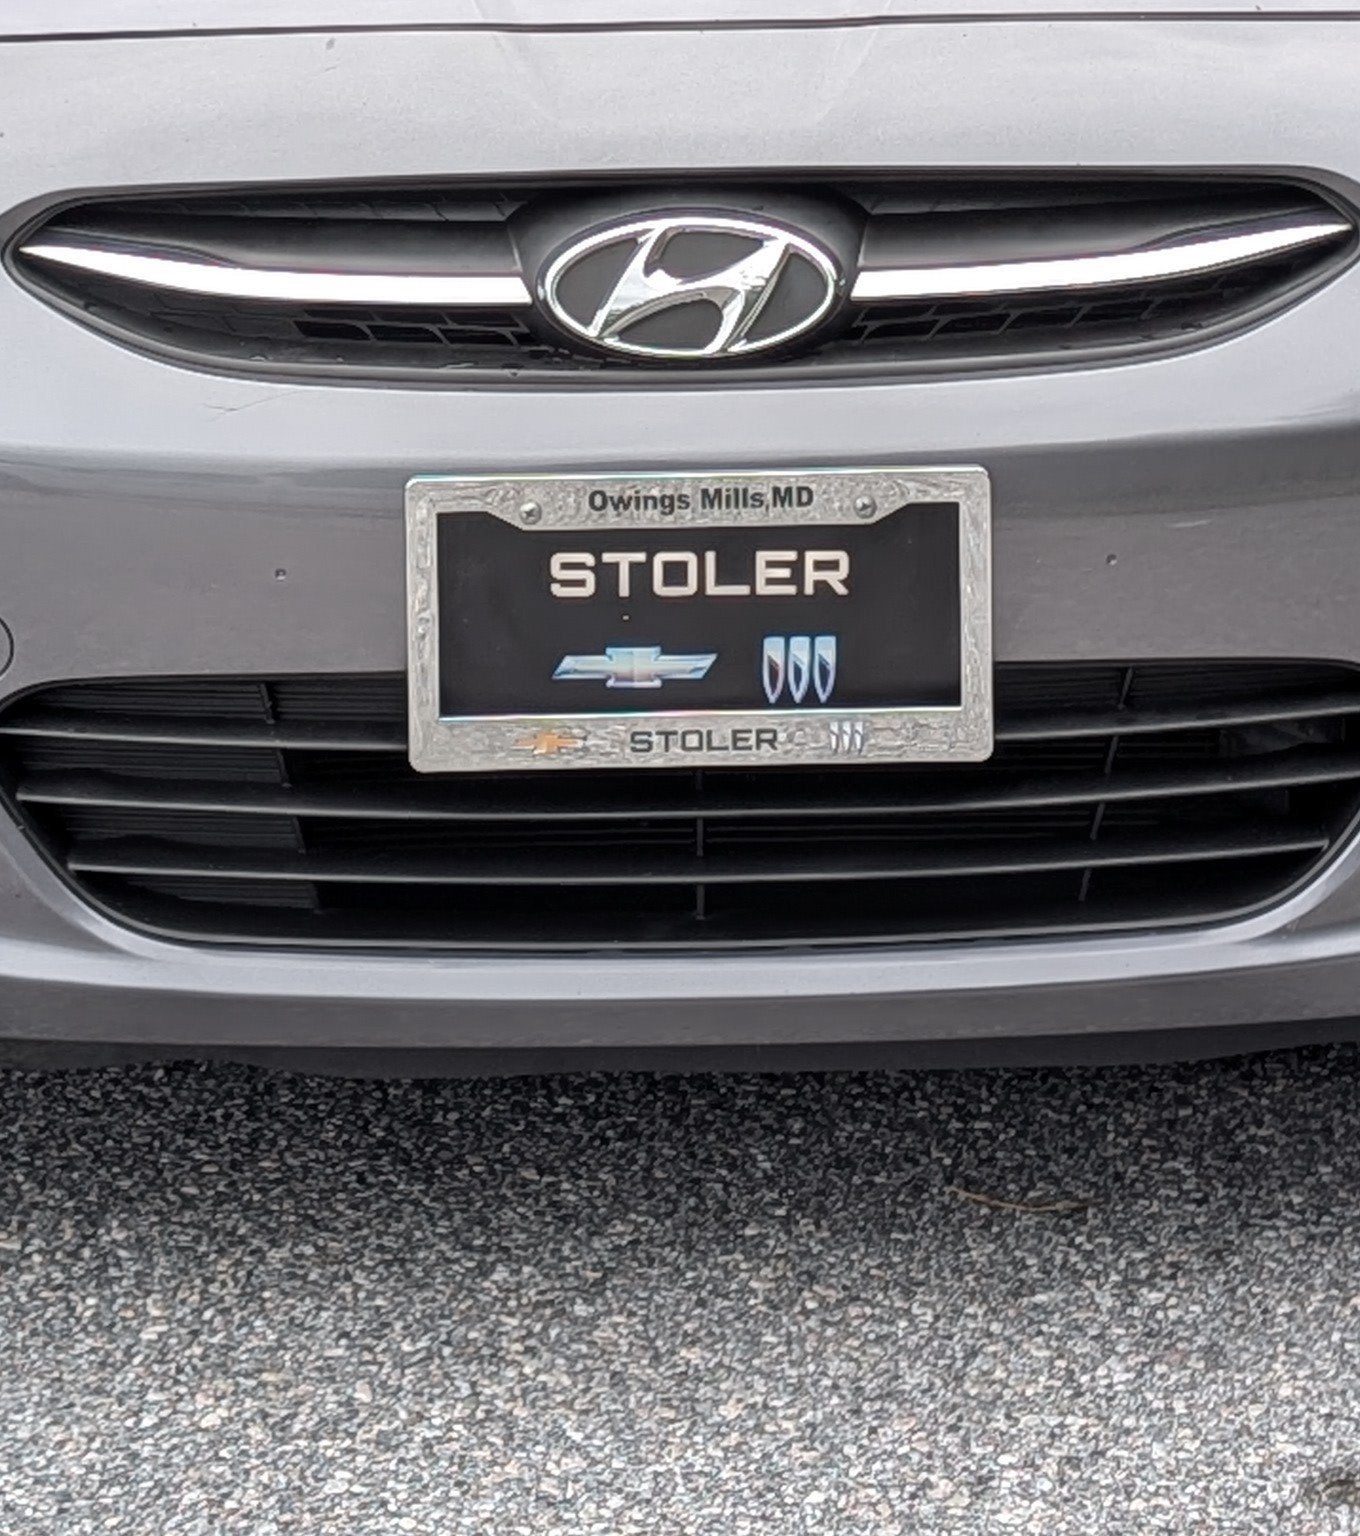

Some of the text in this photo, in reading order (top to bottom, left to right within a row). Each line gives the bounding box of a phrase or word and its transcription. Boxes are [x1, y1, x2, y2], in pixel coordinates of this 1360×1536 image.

[588, 489, 691, 513] Owings
[549, 550, 850, 597] STOLER
[629, 728, 779, 753] STOLER
